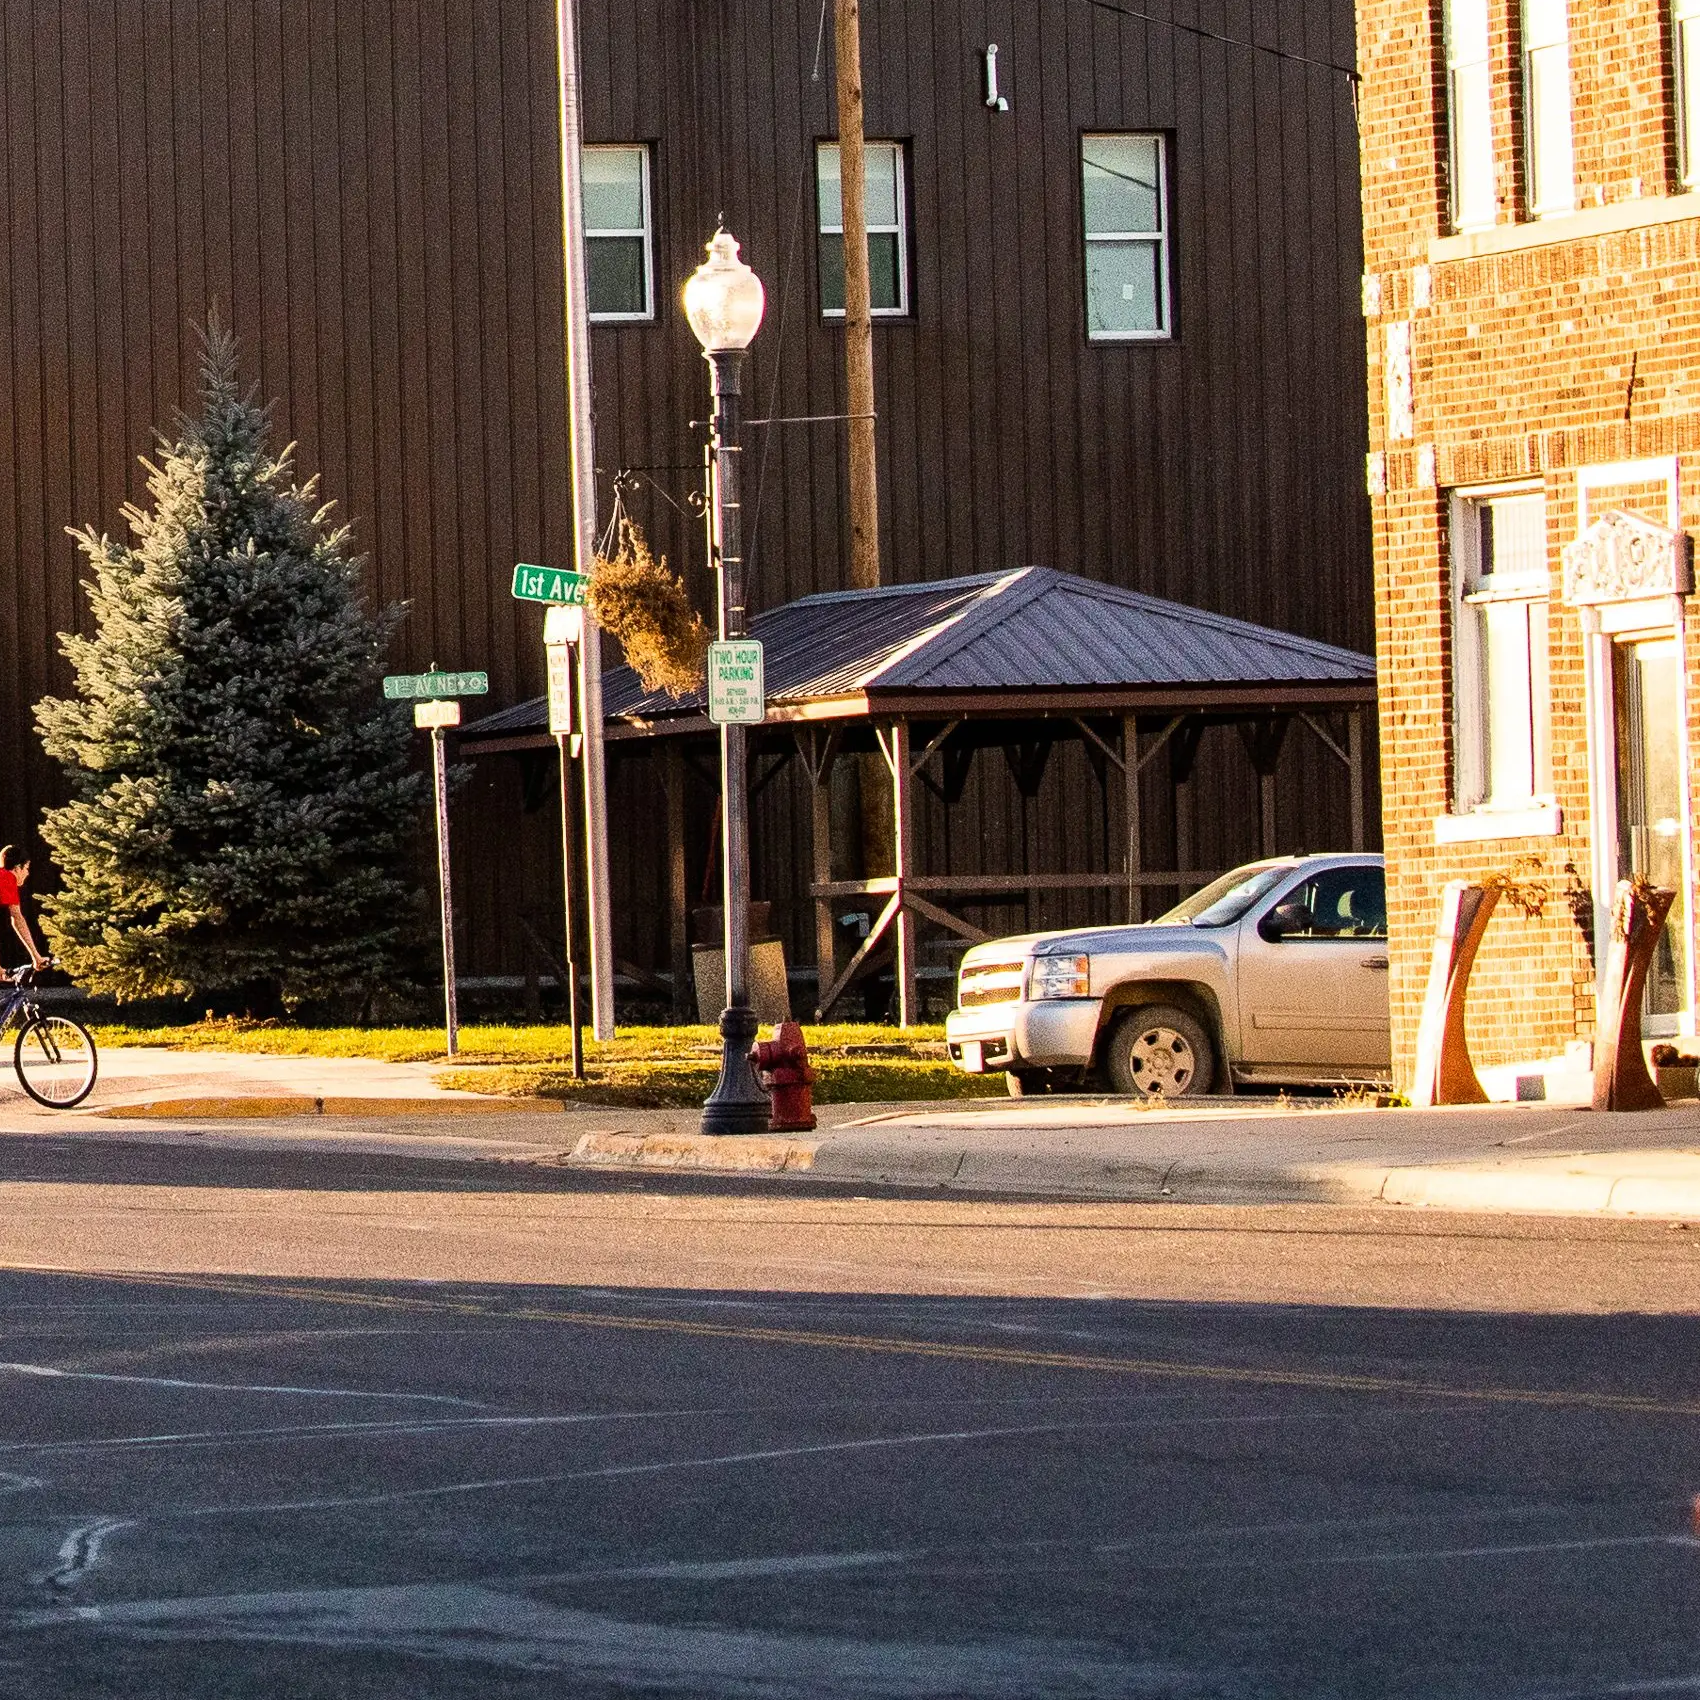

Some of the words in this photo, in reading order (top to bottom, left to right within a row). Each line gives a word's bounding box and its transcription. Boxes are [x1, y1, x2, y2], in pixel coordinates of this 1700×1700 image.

[521, 569, 545, 597] 1st
[549, 574, 586, 604] Ave
[715, 650, 732, 664] TWO
[736, 650, 759, 664] HOUR
[719, 666, 754, 680] PARKING
